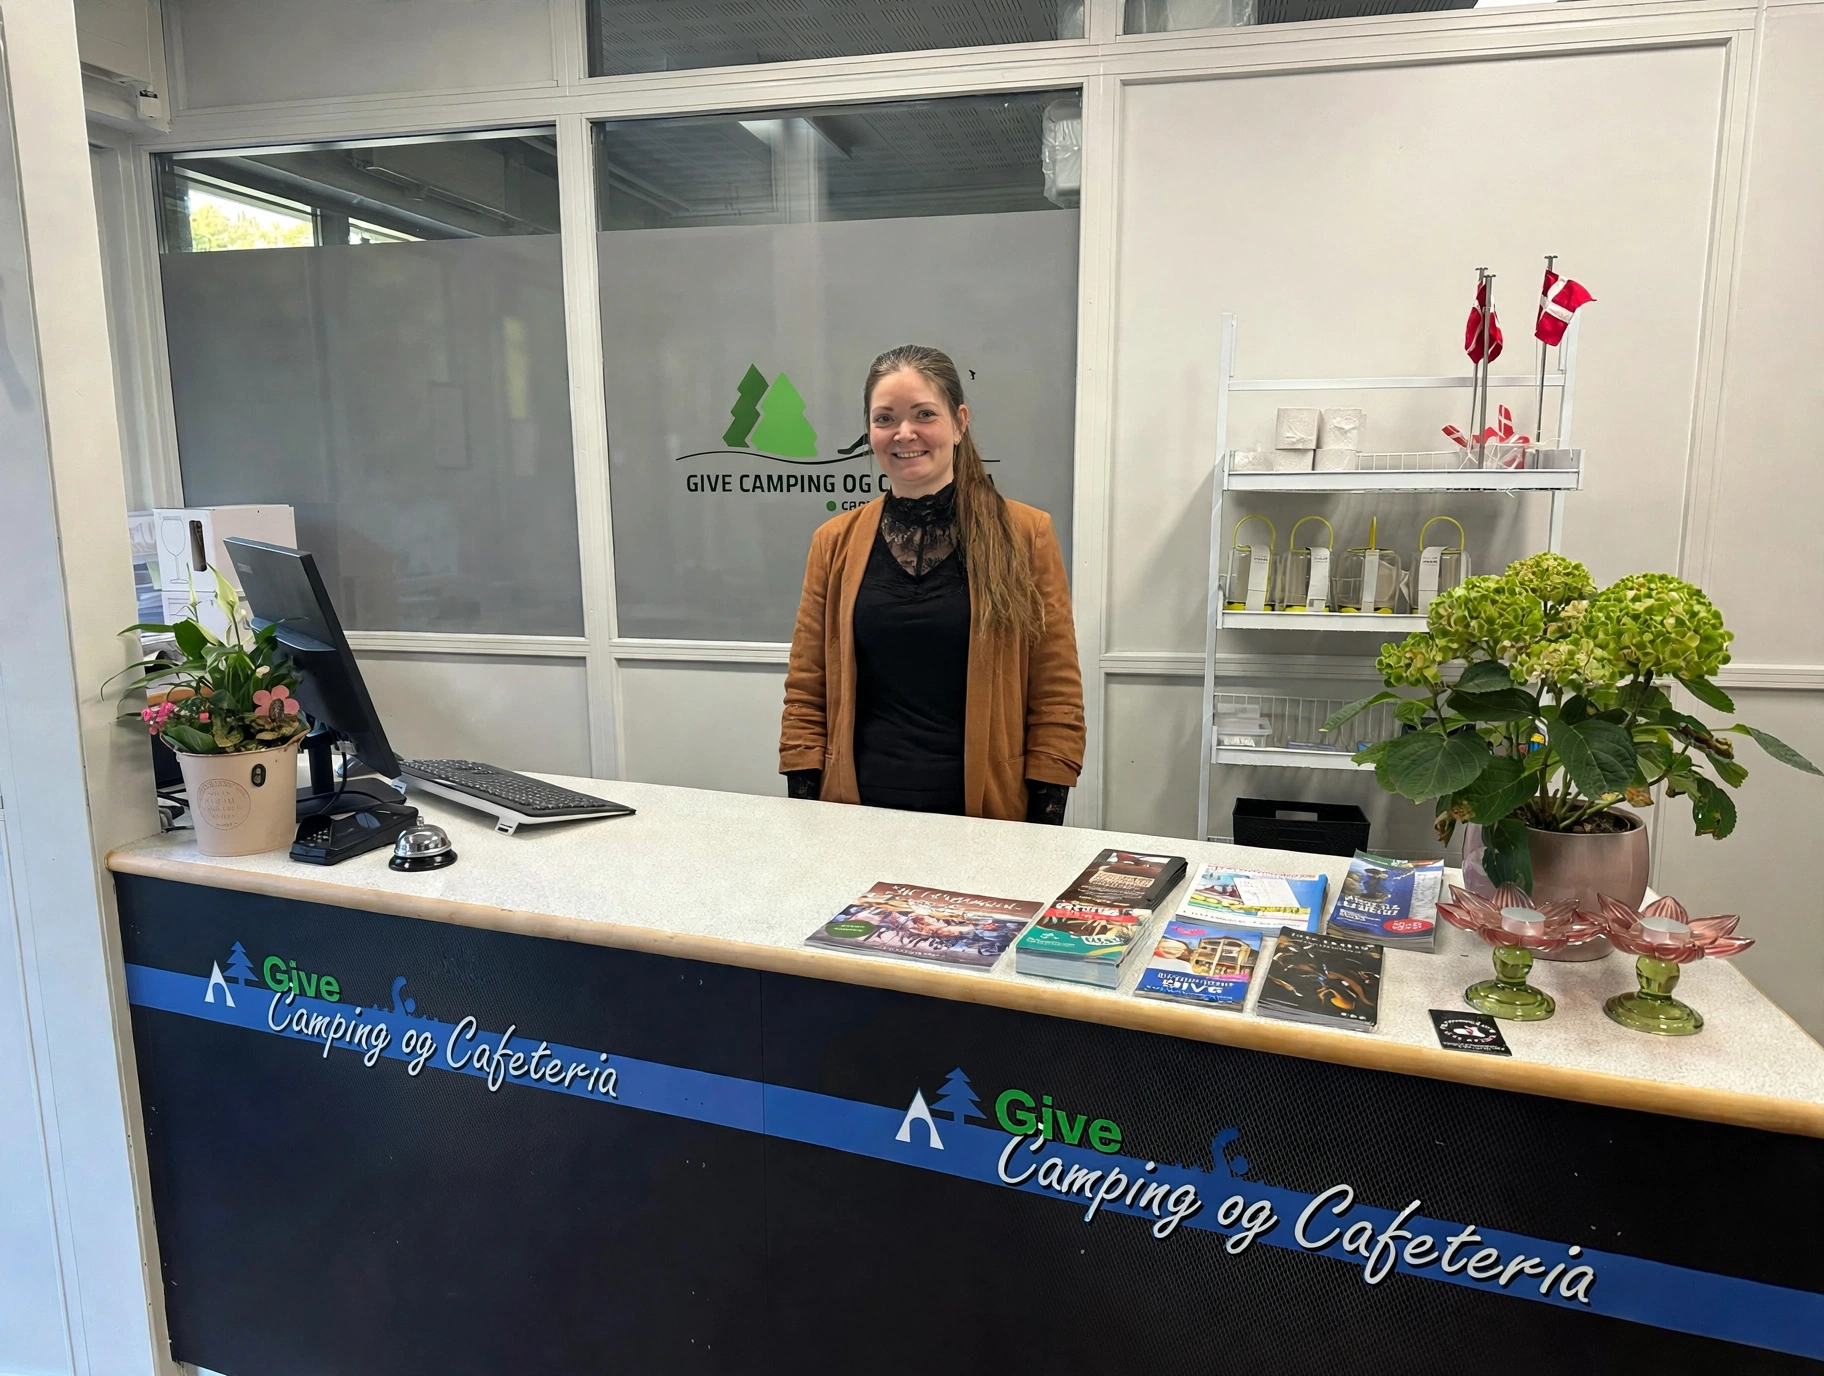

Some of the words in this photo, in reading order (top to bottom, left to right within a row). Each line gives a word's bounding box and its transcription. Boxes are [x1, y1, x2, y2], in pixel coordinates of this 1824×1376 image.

[686, 474, 733, 493] GIVE
[739, 474, 836, 493] CAMPING
[843, 474, 872, 493] OG
[263, 955, 341, 1002] Give
[267, 981, 391, 1068] Camping
[401, 1026, 437, 1076] og
[446, 1015, 619, 1099] Cafeteria
[994, 1088, 1123, 1153] Give
[997, 1121, 1201, 1239] Camping
[1216, 1193, 1279, 1255] og
[1294, 1183, 1595, 1304] Cafeteria
